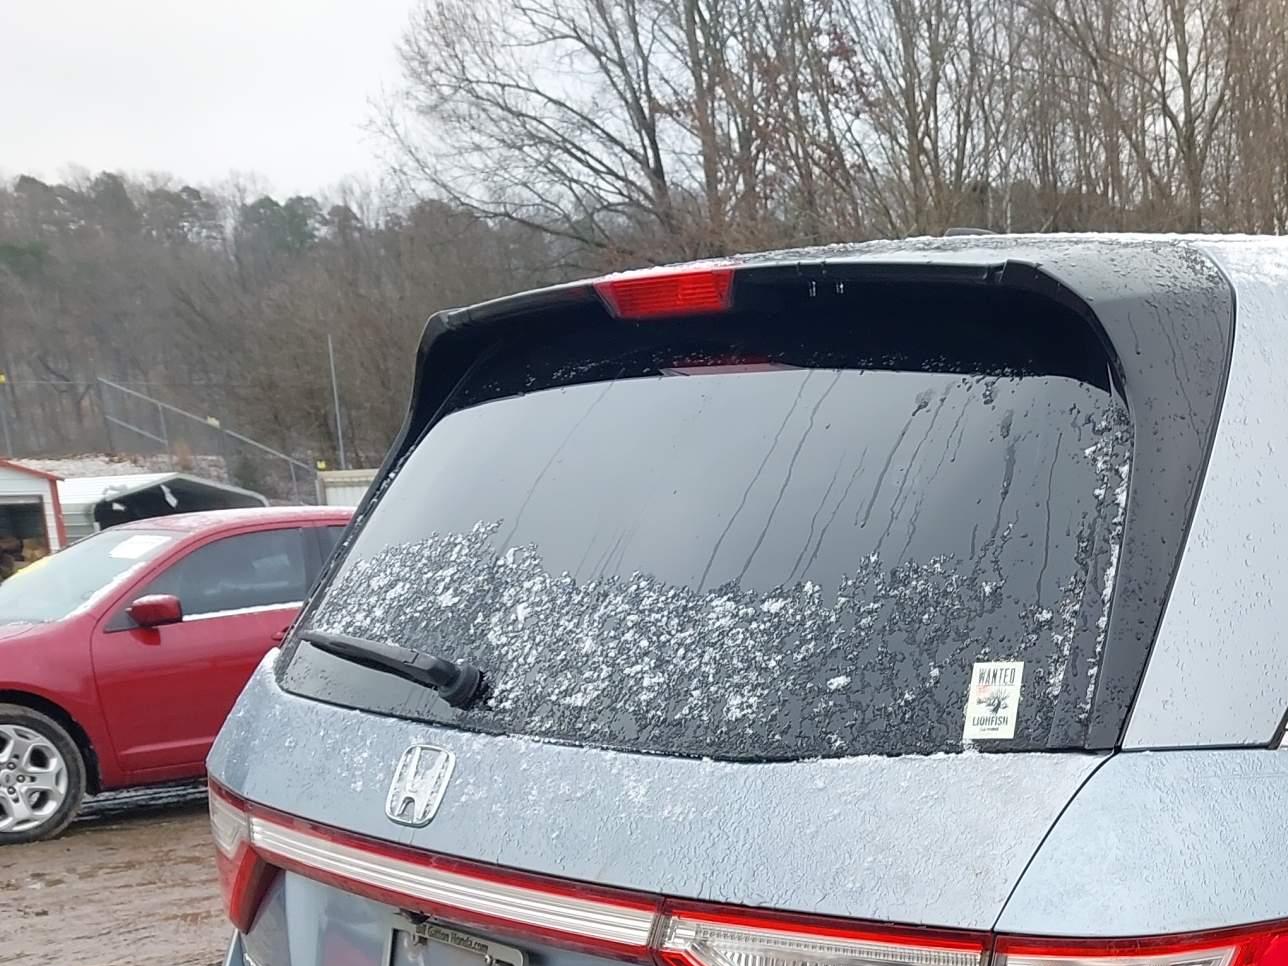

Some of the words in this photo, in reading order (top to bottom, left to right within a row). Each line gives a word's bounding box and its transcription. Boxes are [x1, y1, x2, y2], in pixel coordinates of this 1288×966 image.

[978, 667, 1016, 684] WANTED
[972, 715, 1009, 727] LIONFISH
[450, 932, 490, 953] Honda.com
